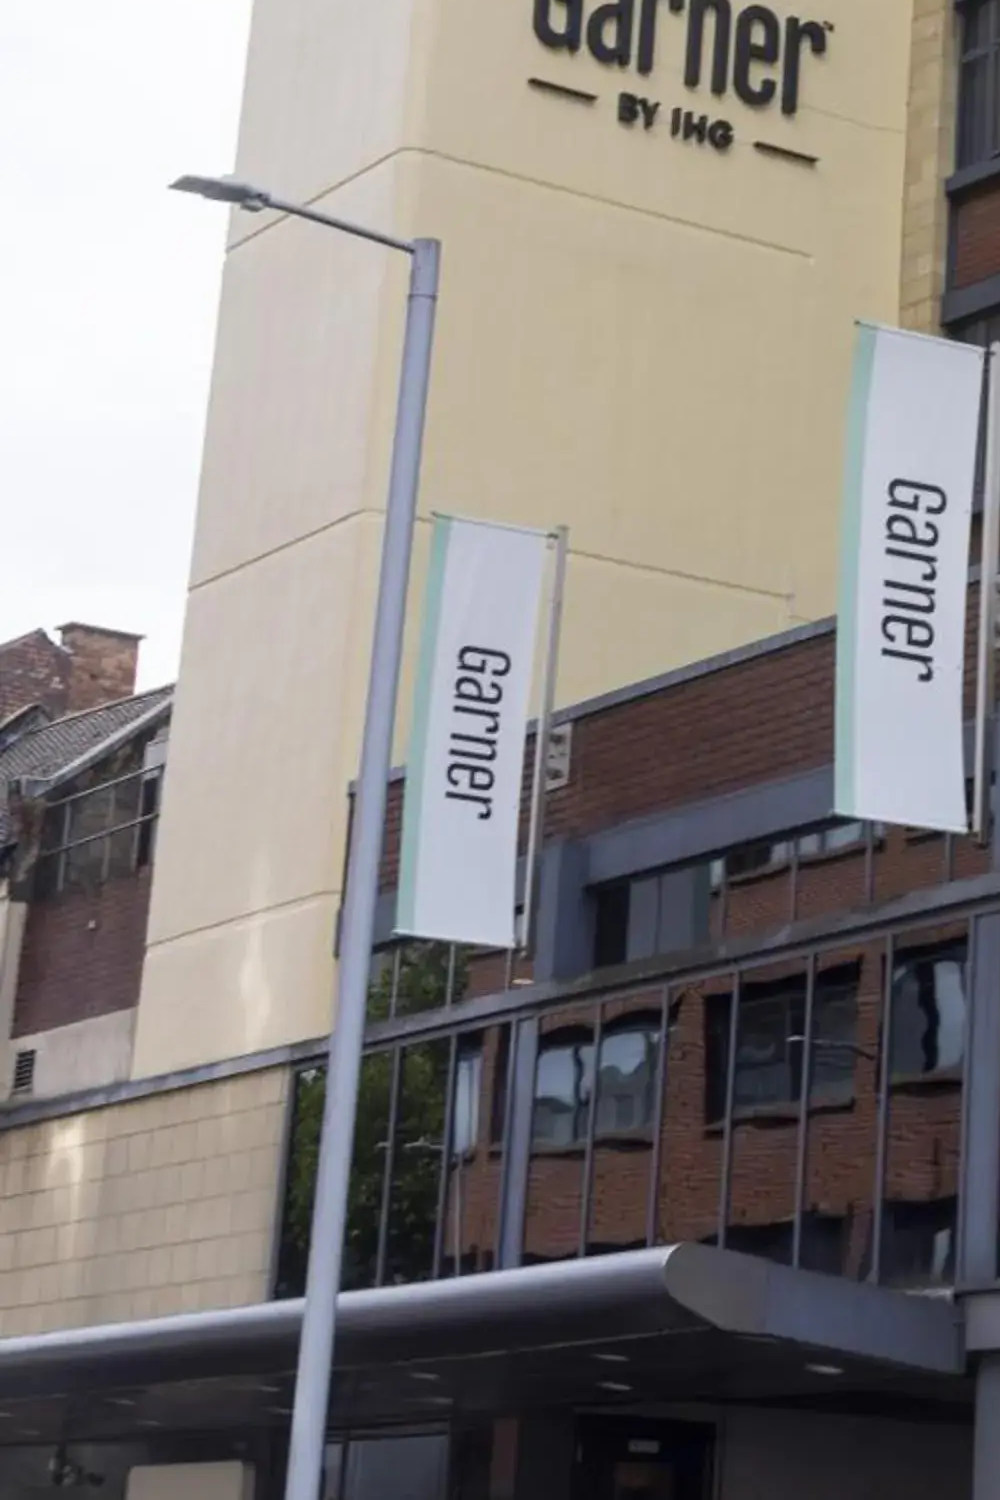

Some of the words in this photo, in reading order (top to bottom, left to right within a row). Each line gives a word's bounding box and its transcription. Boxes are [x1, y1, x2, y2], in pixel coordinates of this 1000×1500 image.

[617, 92, 660, 130] BY
[670, 106, 734, 152] IHG
[881, 477, 948, 683] Garner
[445, 645, 512, 821] Garner
